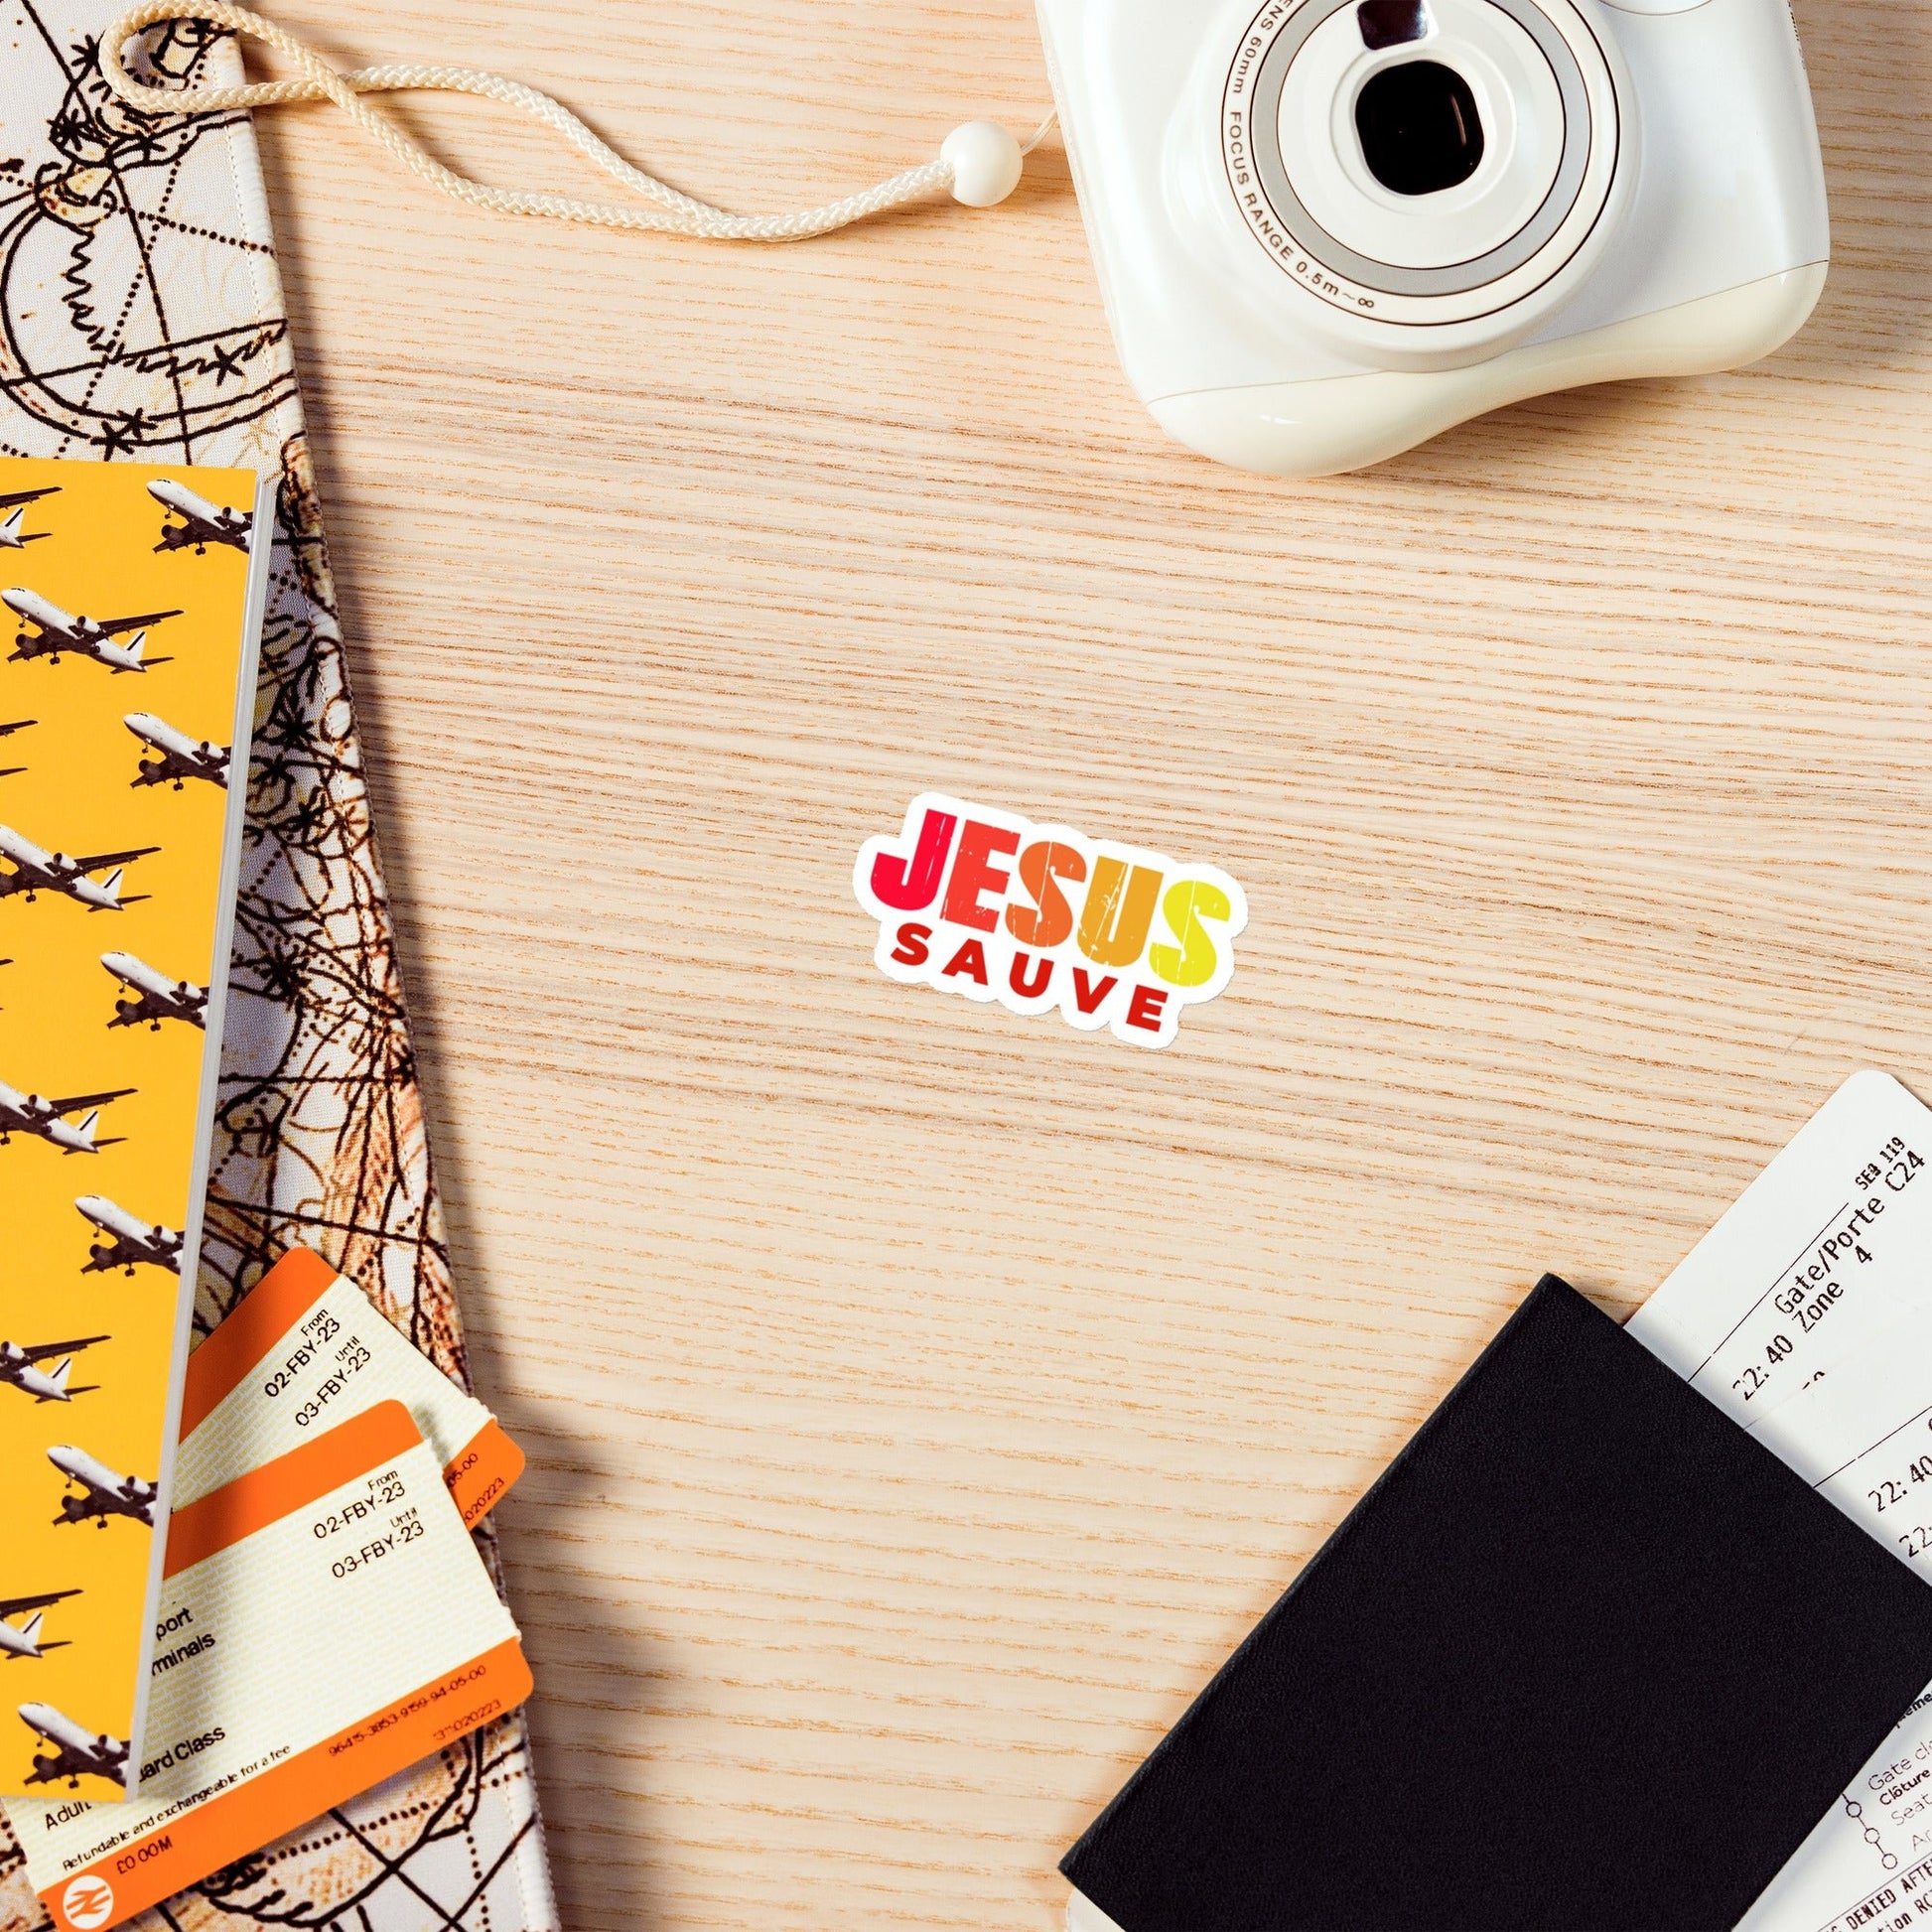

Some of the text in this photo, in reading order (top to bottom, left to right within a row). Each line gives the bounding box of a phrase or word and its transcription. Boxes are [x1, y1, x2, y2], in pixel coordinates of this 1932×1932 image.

[1233, 37, 1262, 93] 60mm
[1229, 111, 1250, 186] FOCUS
[1244, 192, 1295, 260] RANGE
[870, 808, 1231, 988] JESUS
[891, 922, 1169, 1033] SAUVE
[1879, 1137, 1905, 1163] 119
[1774, 1150, 1925, 1314] Gate/Porte C24
[1792, 1281, 1844, 1333] Zone
[1855, 1245, 1873, 1265] 4
[300, 1309, 329, 1336] From
[264, 1317, 341, 1398] 02-FBY-23
[295, 1346, 371, 1427] 03-FBY-23
[313, 1480, 406, 1540] 02-FBY-23
[367, 1469, 399, 1491] From
[332, 1520, 425, 1580] 03-FBY-23
[174, 1726, 226, 1760] Class
[1867, 1758, 1912, 1791] Gate
[62, 1745, 291, 1871] Refundable and exchangeable for a fee
[1879, 1768, 1931, 1806] Clôture
[1890, 1792, 1932, 1826] Seat
[1846, 1858, 1932, 1930] DENIED AFTE
